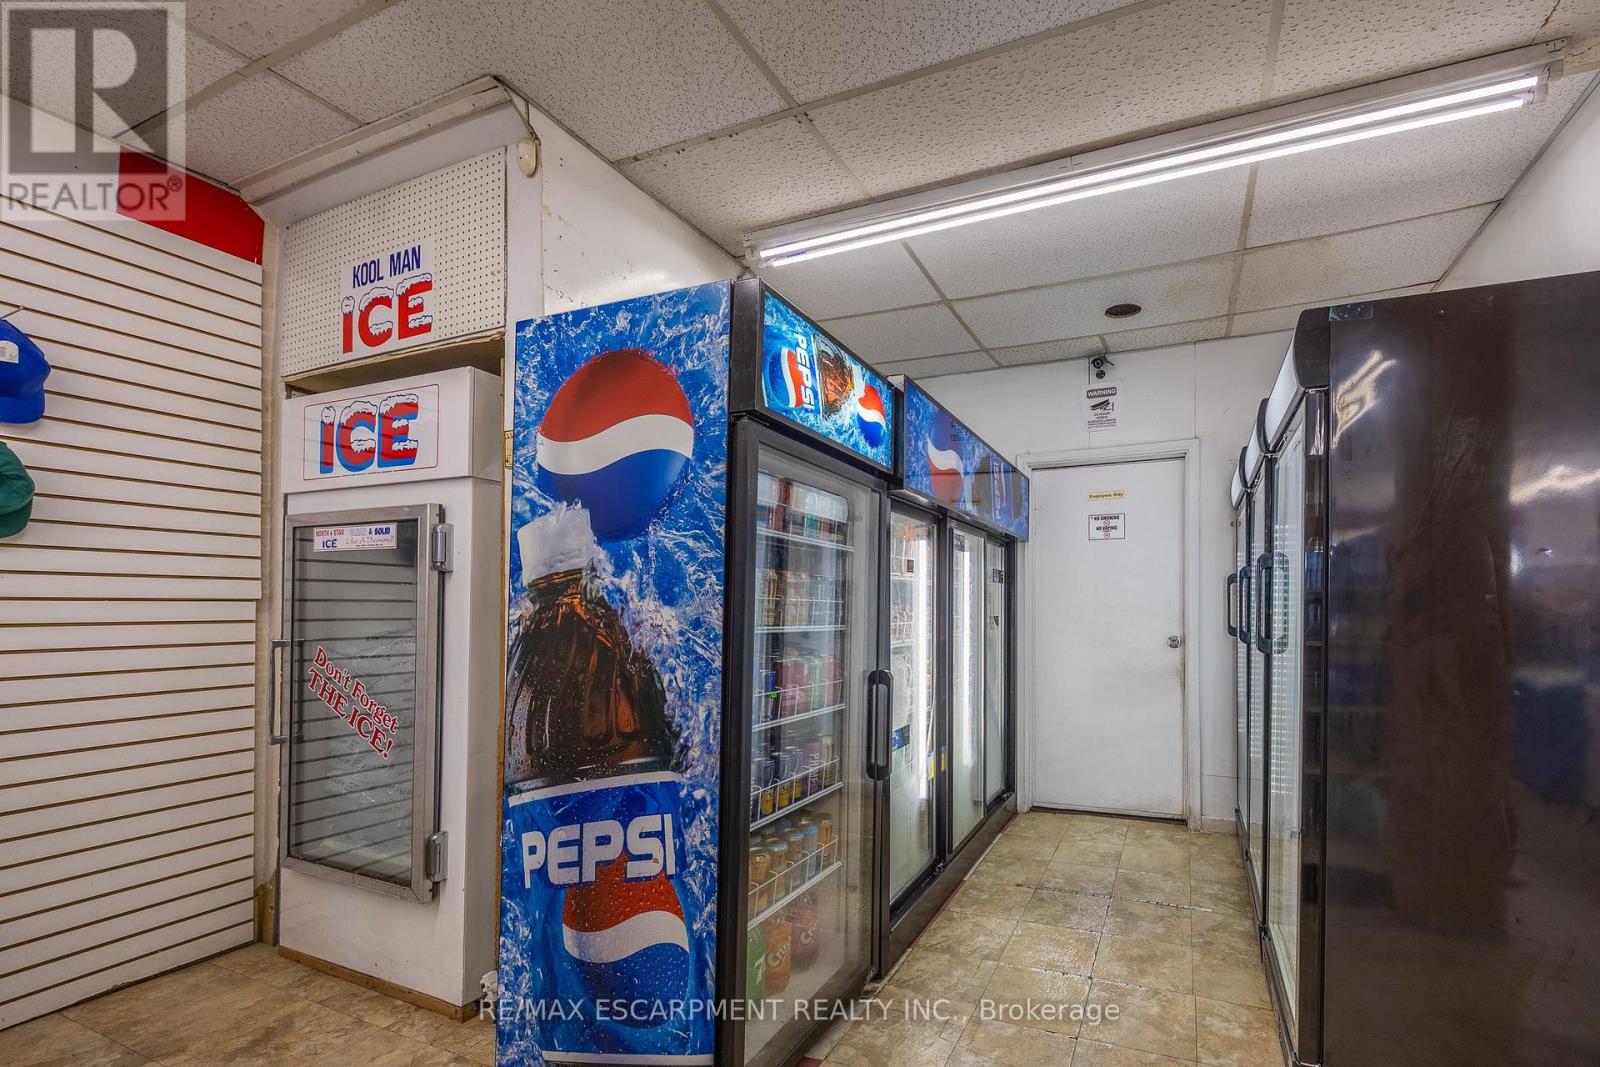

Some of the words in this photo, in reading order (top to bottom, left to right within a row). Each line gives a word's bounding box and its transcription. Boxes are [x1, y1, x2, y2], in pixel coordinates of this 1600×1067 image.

[353, 258, 384, 288] KOOL
[389, 245, 421, 277] MAN
[341, 272, 433, 355] ICE
[794, 333, 815, 410] PEPSI
[1088, 388, 1116, 397] WARNING
[320, 393, 419, 474] ICE
[322, 539, 338, 548] ICE
[374, 526, 391, 535] SOLID
[308, 667, 348, 719] THE
[347, 706, 394, 760] ICE!
[313, 646, 351, 691] Don't
[350, 679, 399, 734] Forget
[521, 813, 676, 889] PEPSI
